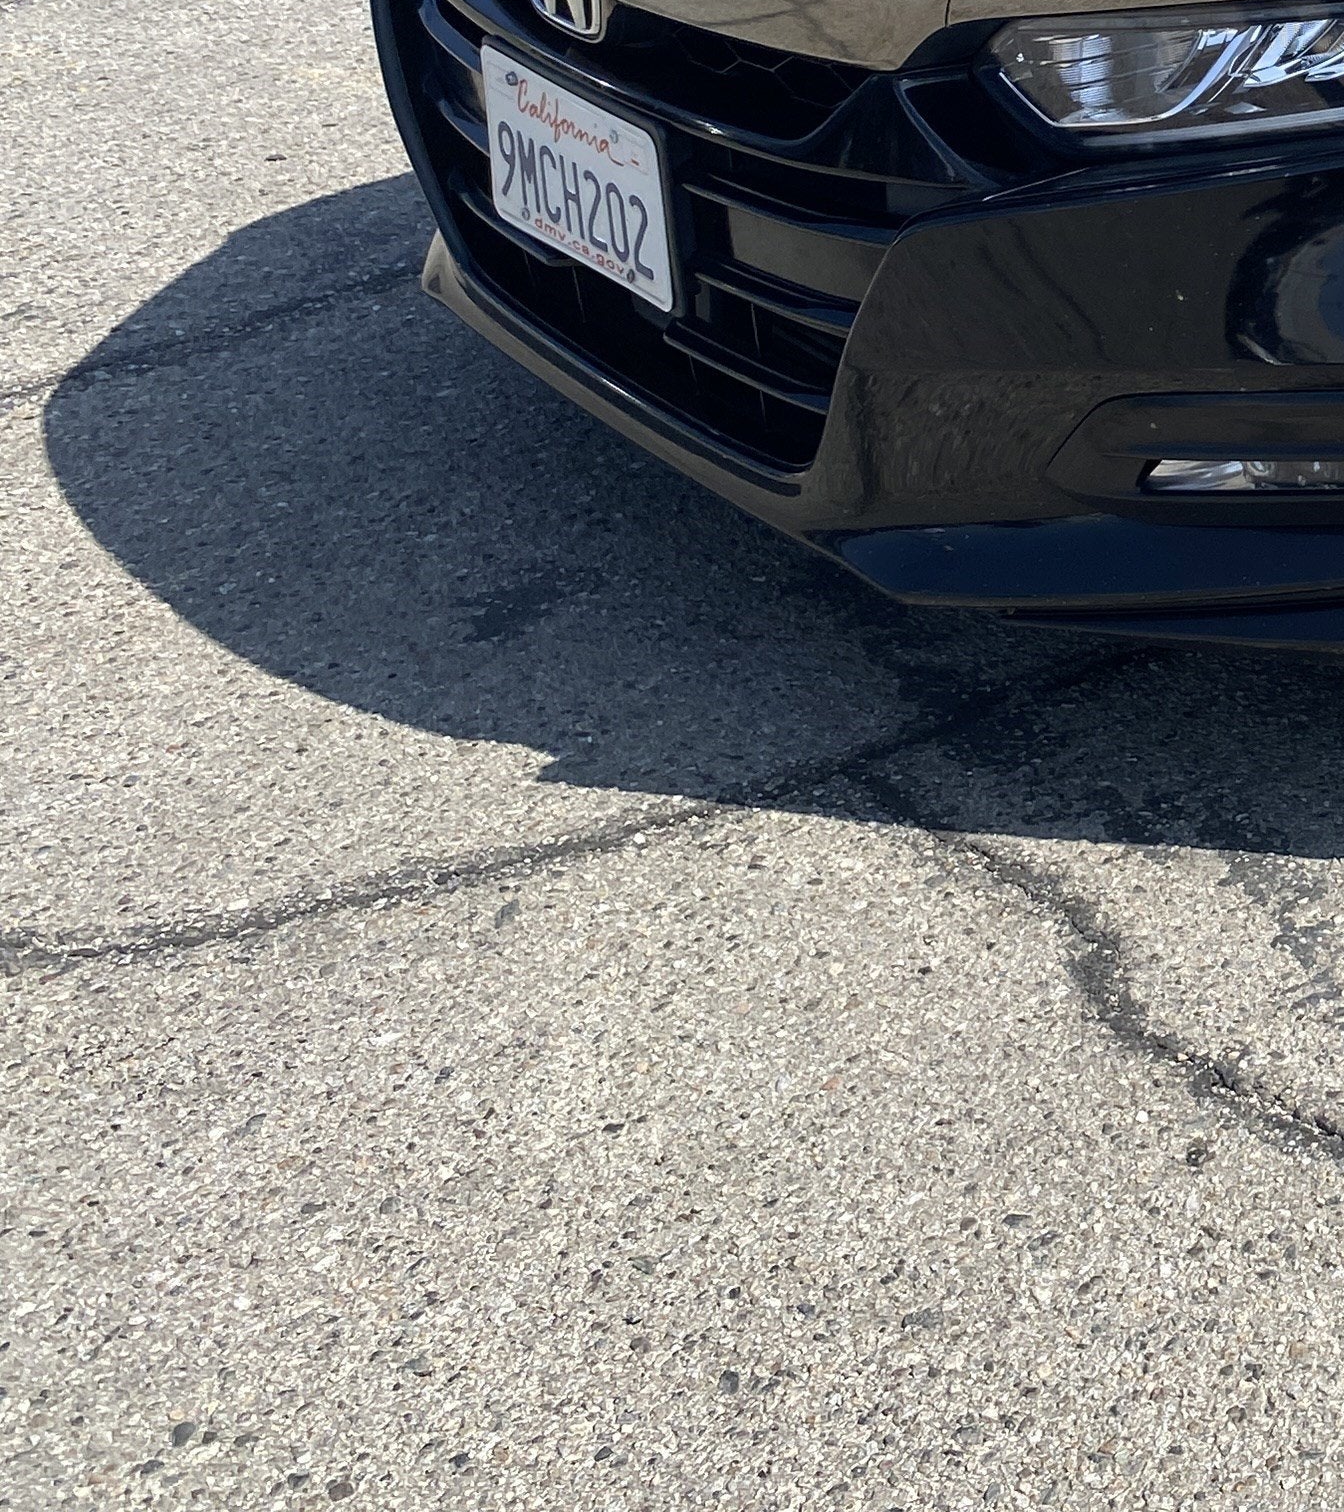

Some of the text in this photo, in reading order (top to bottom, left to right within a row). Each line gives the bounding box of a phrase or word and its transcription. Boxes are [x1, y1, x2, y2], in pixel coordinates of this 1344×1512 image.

[517, 79, 624, 166] California
[498, 120, 655, 280] 9MCH202
[534, 217, 625, 275] dmv.ca.gov
